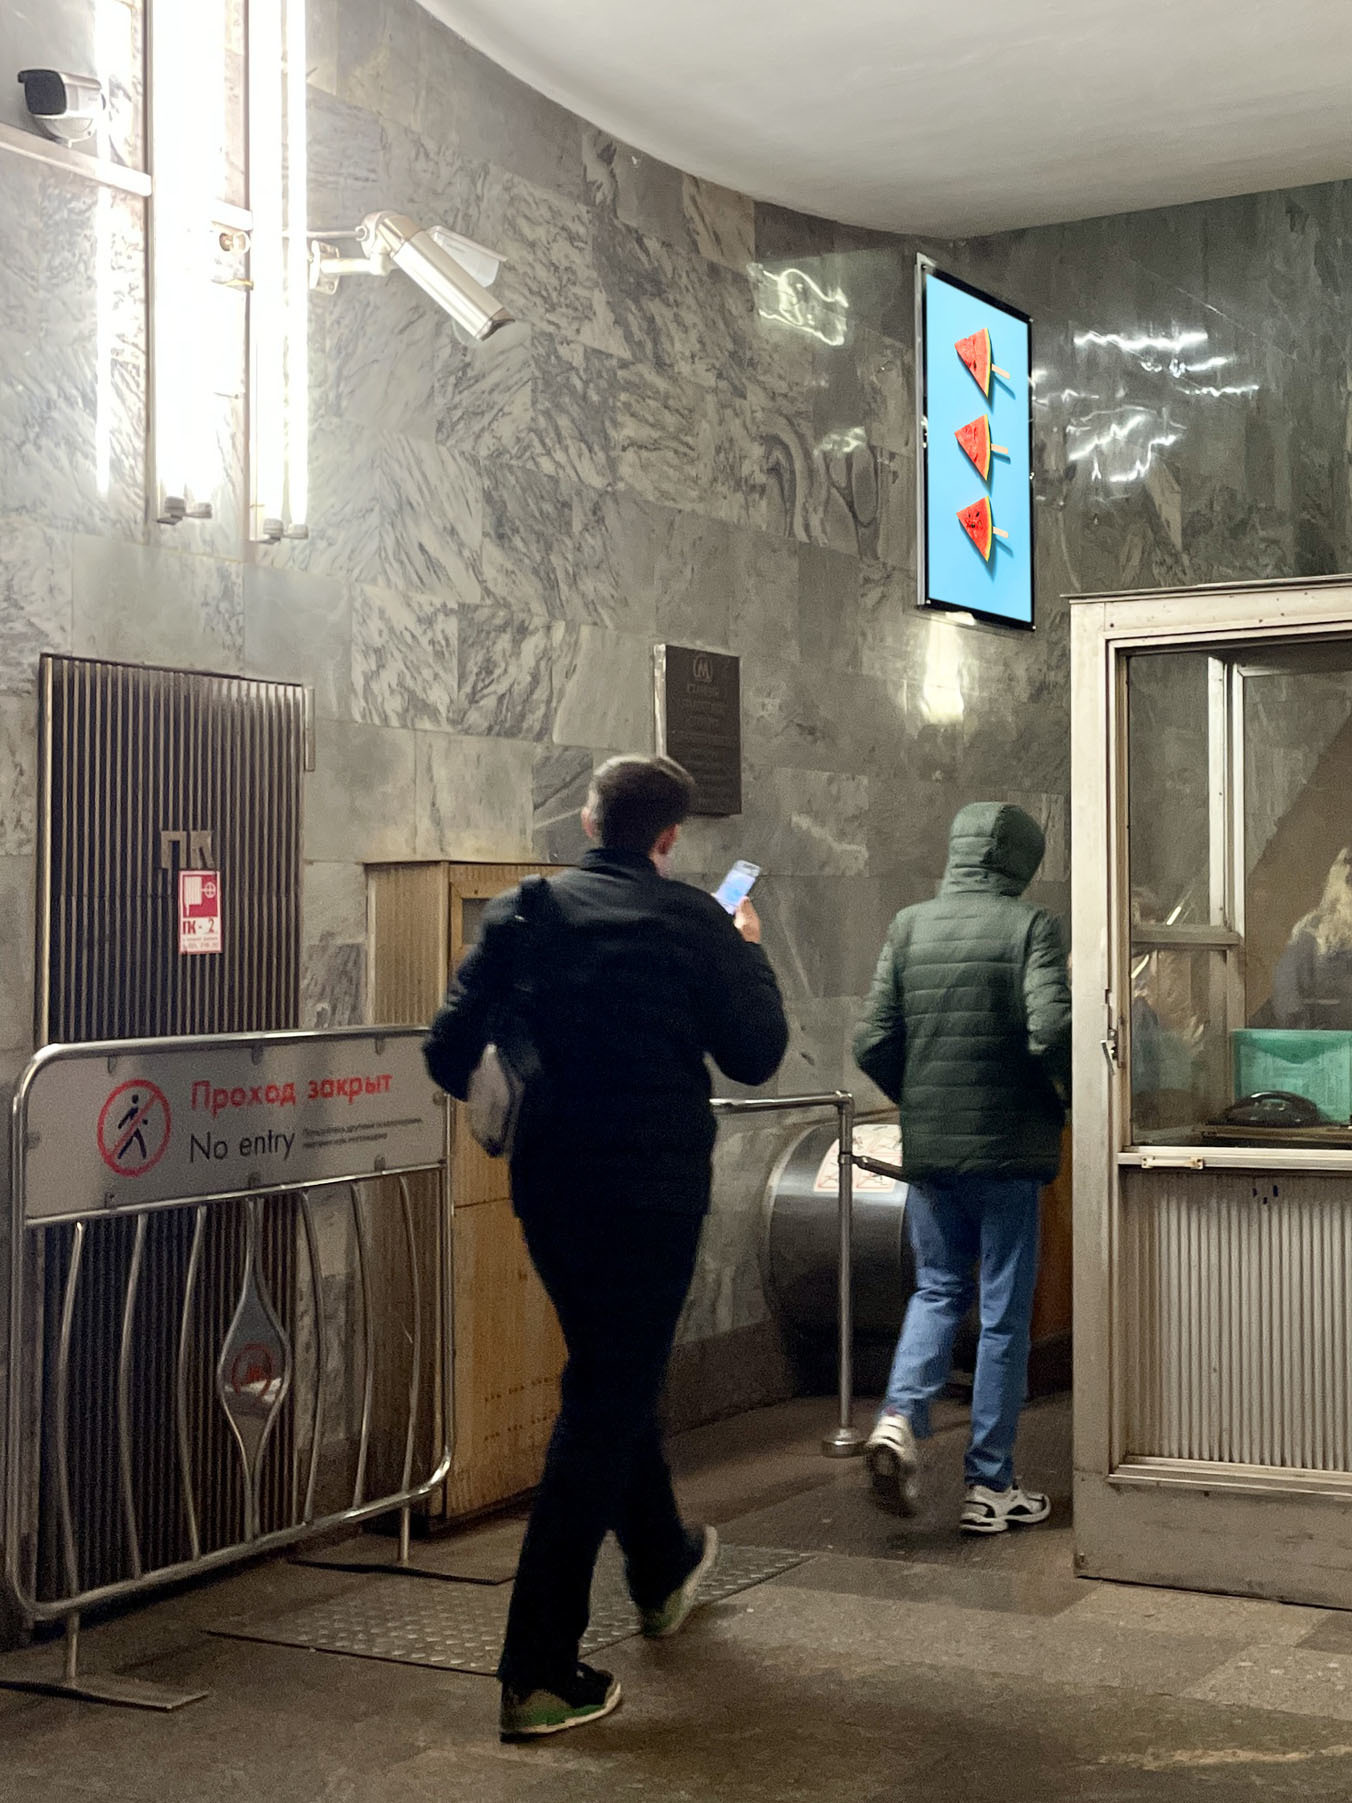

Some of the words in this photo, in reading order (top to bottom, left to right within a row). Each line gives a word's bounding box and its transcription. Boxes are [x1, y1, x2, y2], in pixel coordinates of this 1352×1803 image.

[160, 830, 217, 870] ПК
[190, 1079, 297, 1119] Проход
[307, 1073, 393, 1105] закрыт
[189, 1131, 229, 1164] No
[239, 1129, 296, 1161] entry
